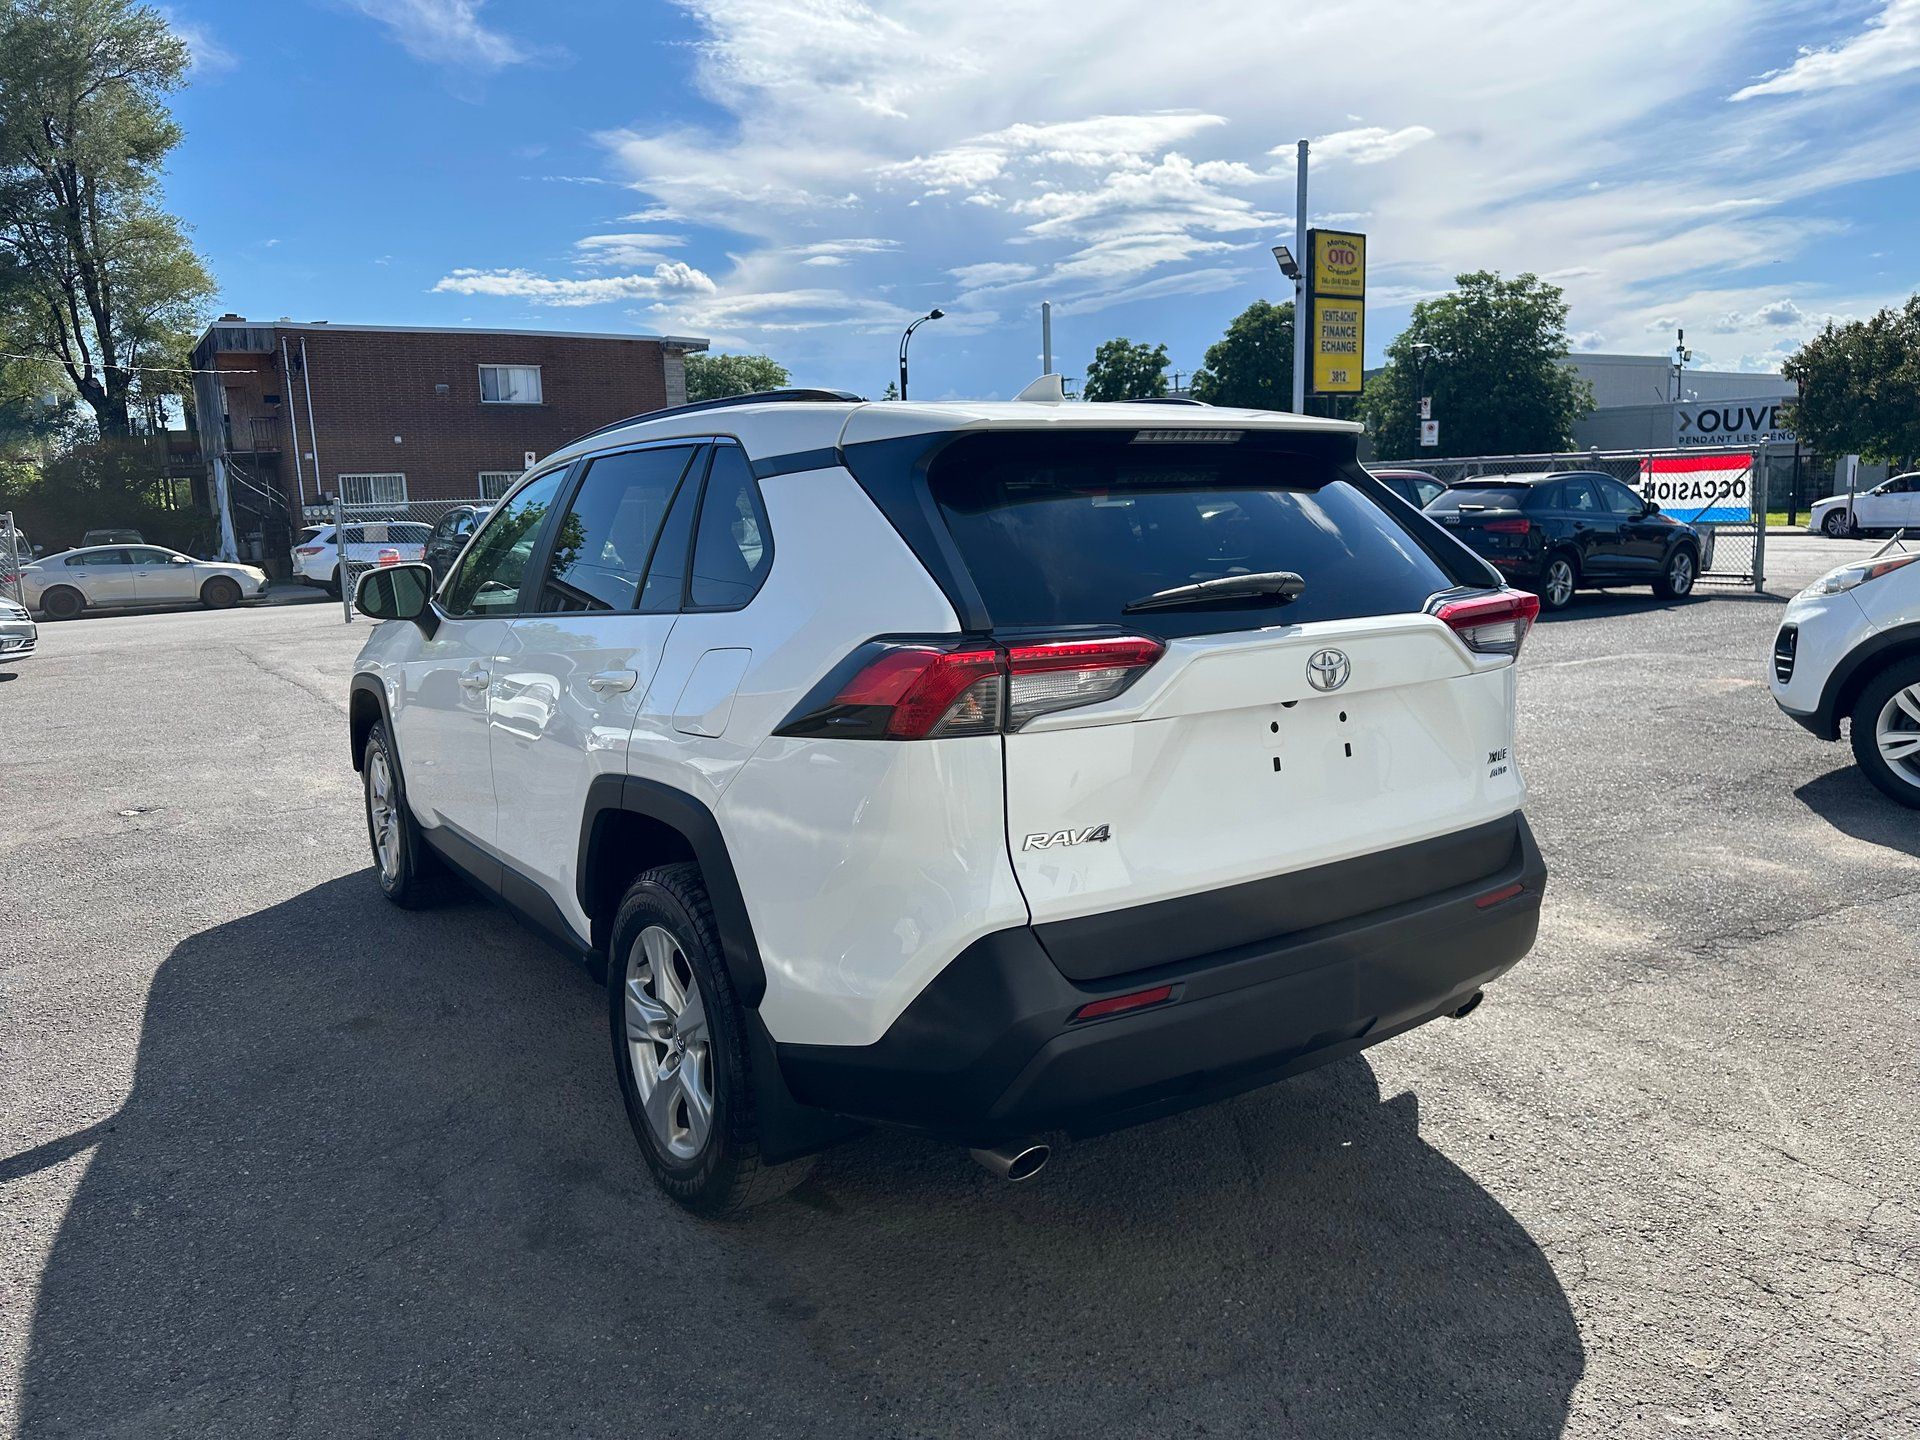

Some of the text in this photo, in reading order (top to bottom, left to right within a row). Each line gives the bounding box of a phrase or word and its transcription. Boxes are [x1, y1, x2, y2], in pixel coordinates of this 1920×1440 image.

[1329, 249, 1355, 265] OTO
[1322, 325, 1357, 337] FINANCE
[1321, 341, 1357, 352] ECHANGE
[1679, 434, 1732, 445] PENDANT
[1737, 433, 1757, 442] LES
[1022, 823, 1111, 852] RAV4
